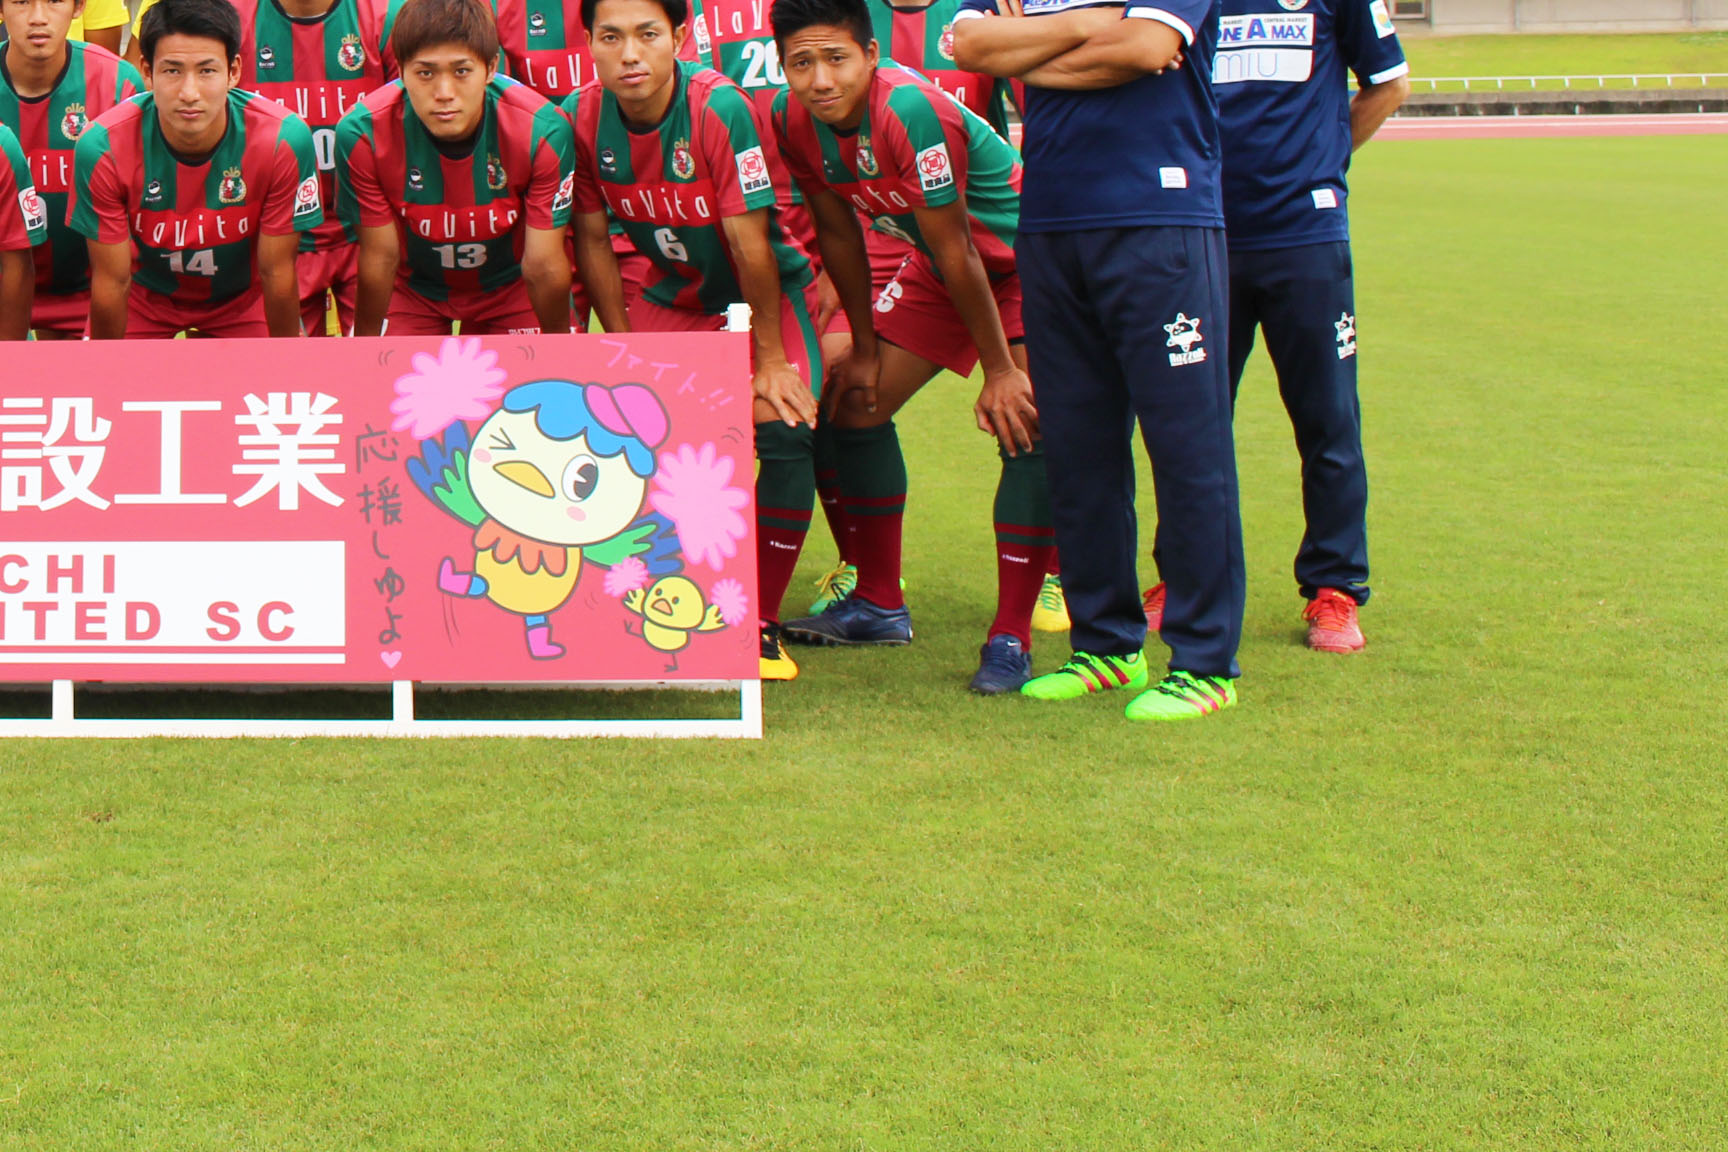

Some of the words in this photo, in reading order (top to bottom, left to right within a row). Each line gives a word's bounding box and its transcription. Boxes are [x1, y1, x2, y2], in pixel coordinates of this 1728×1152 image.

[714, 0, 763, 37] LaV
[526, 53, 598, 89] LaV
[401, 206, 518, 239] aVita
[431, 243, 488, 269] 13
[653, 227, 689, 262] 6
[160, 249, 219, 276] 14
[205, 600, 296, 641] SC
